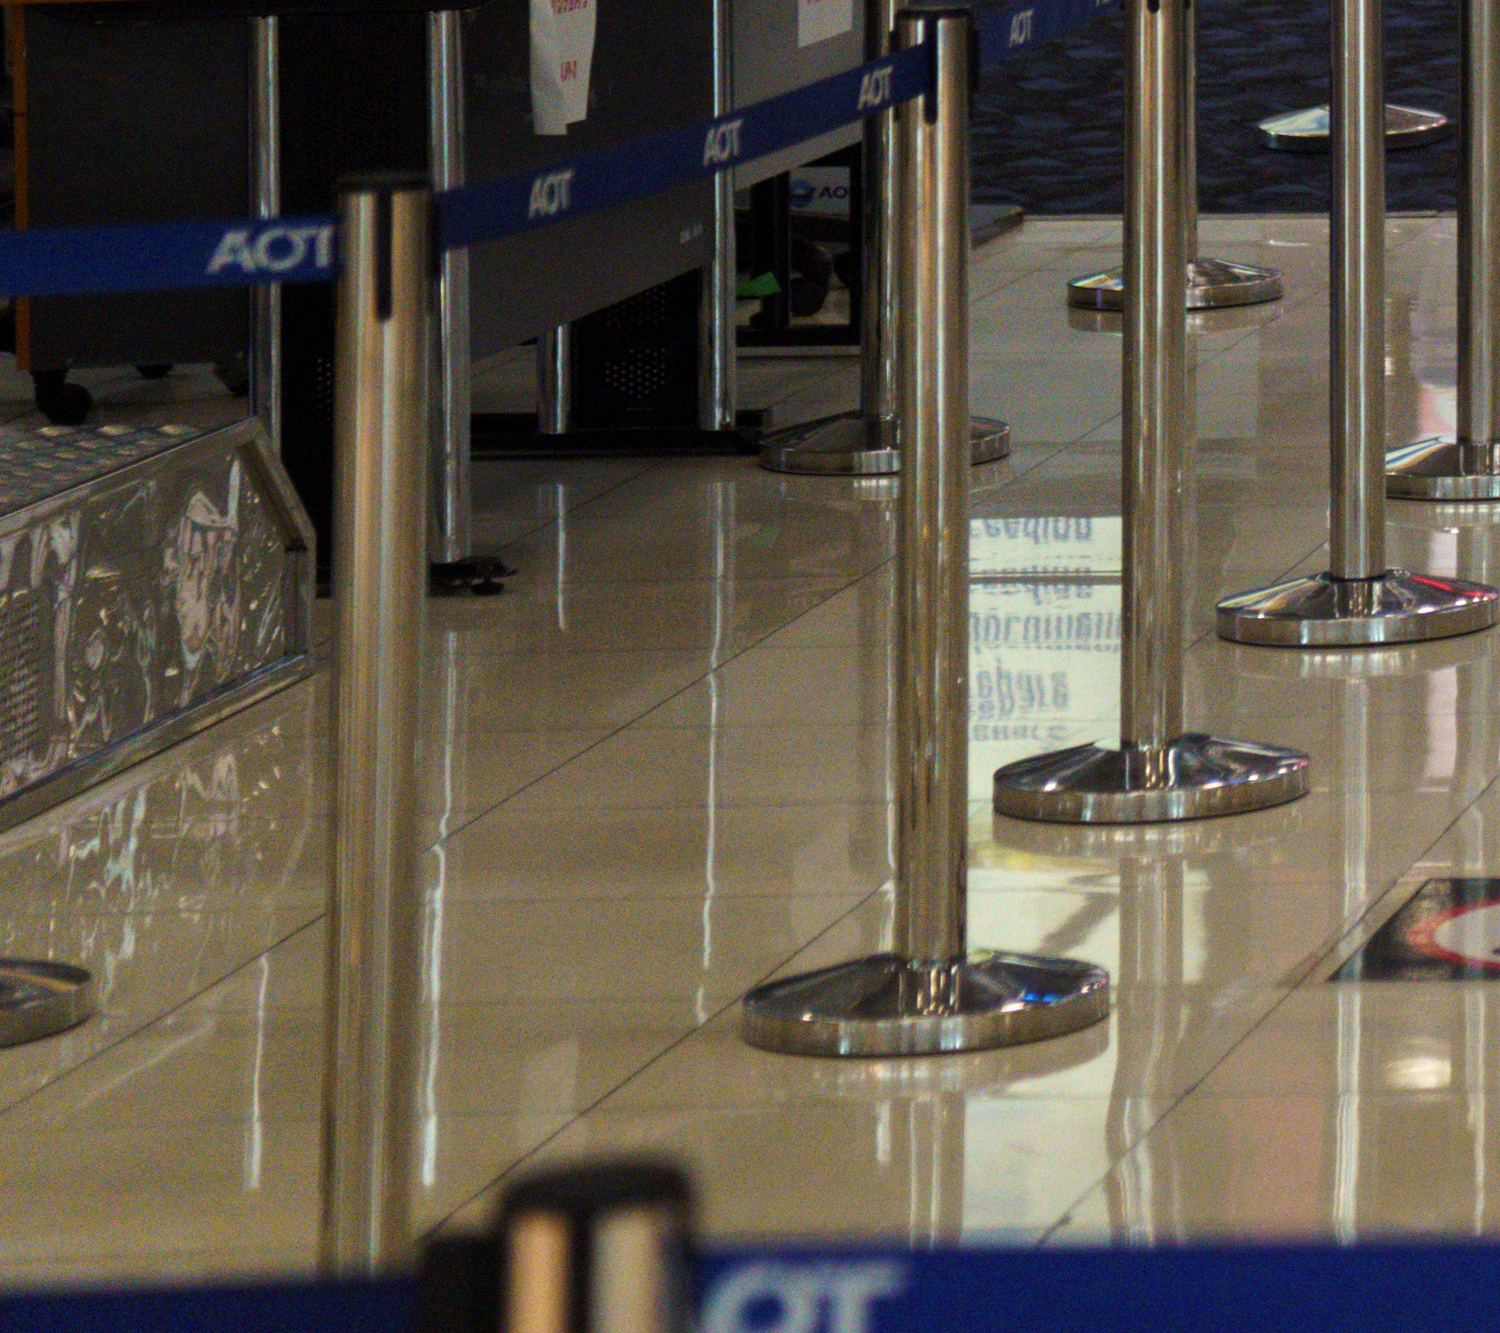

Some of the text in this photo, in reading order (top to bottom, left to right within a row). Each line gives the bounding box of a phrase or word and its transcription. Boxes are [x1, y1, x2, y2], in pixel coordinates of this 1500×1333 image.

[858, 65, 893, 111] AOT
[703, 119, 744, 167] AOT
[529, 167, 574, 221] AOT
[206, 225, 335, 275] AOT
